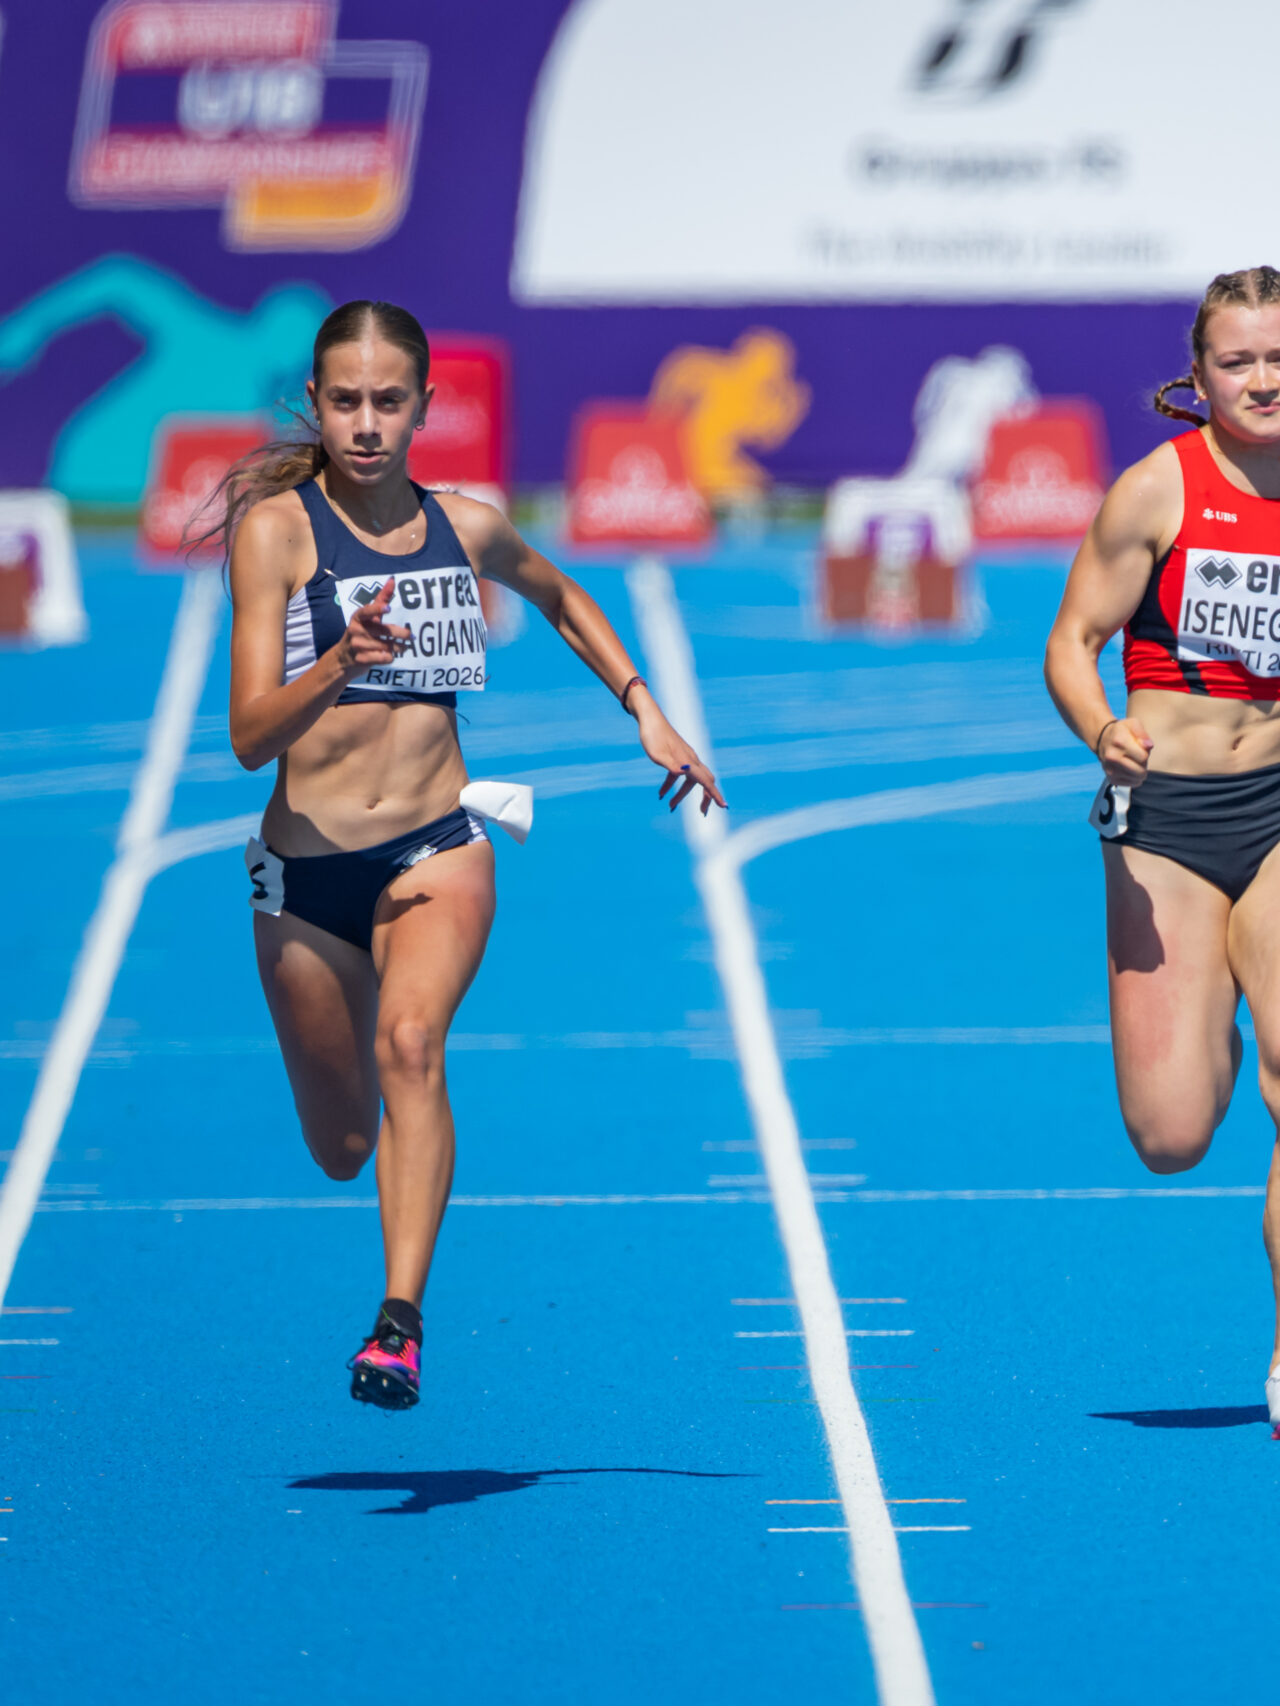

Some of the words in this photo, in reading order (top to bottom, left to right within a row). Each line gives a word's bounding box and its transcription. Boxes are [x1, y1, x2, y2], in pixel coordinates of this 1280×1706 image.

[1216, 511, 1238, 523] UBS
[398, 574, 478, 610] errea
[394, 617, 487, 659] AGIANN
[366, 669, 426, 687] RIETI
[433, 666, 484, 687] 2026
